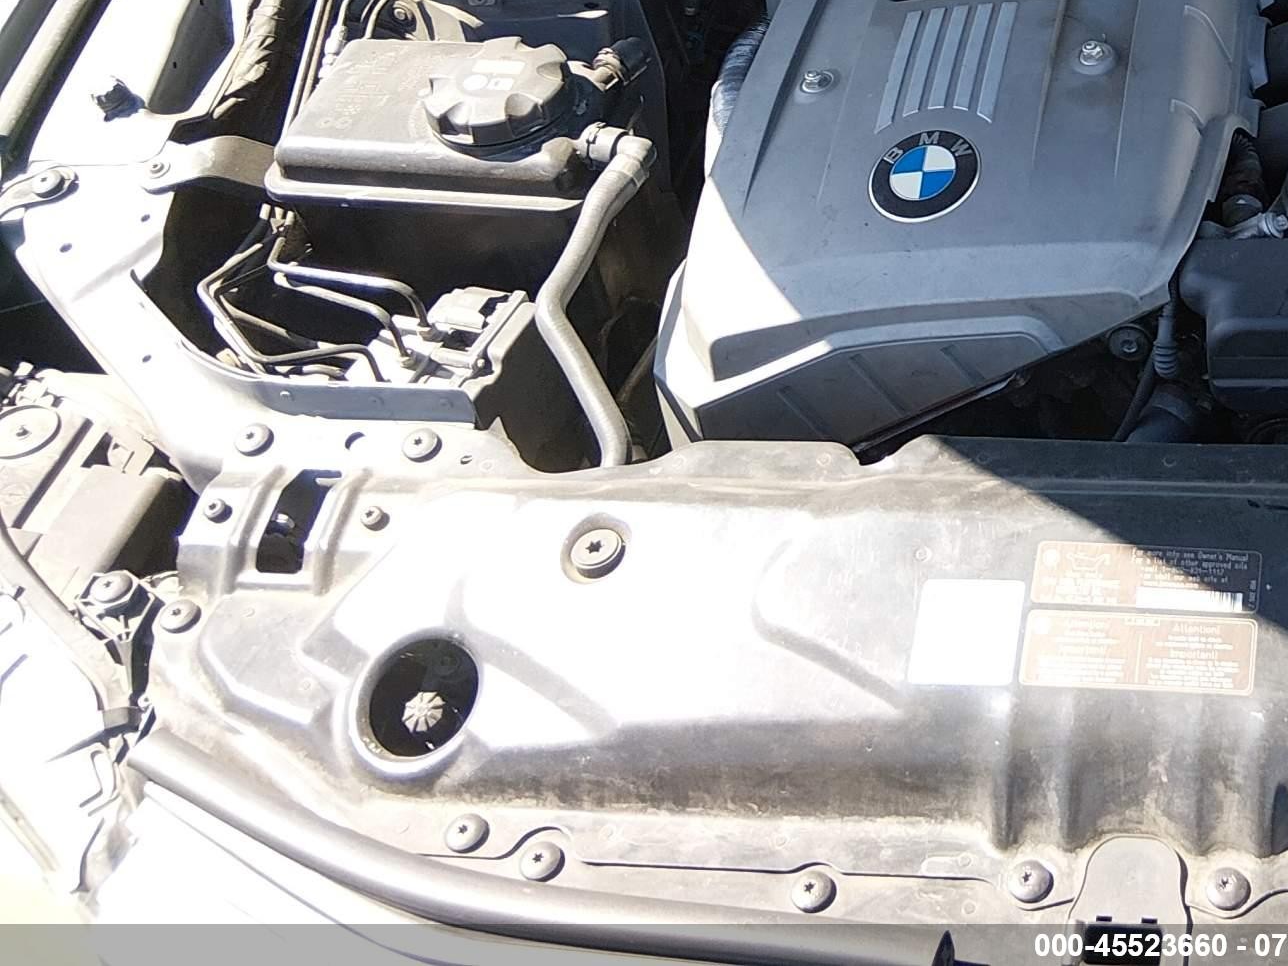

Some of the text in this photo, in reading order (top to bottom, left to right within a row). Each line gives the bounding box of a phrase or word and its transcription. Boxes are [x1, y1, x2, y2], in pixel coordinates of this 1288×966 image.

[883, 131, 974, 165] BMW
[1197, 551, 1223, 561] Owner's
[1225, 553, 1249, 562] Manual
[1202, 561, 1232, 570] approved
[1172, 622, 1221, 635] Attention!
[1170, 649, 1219, 660] Important!
